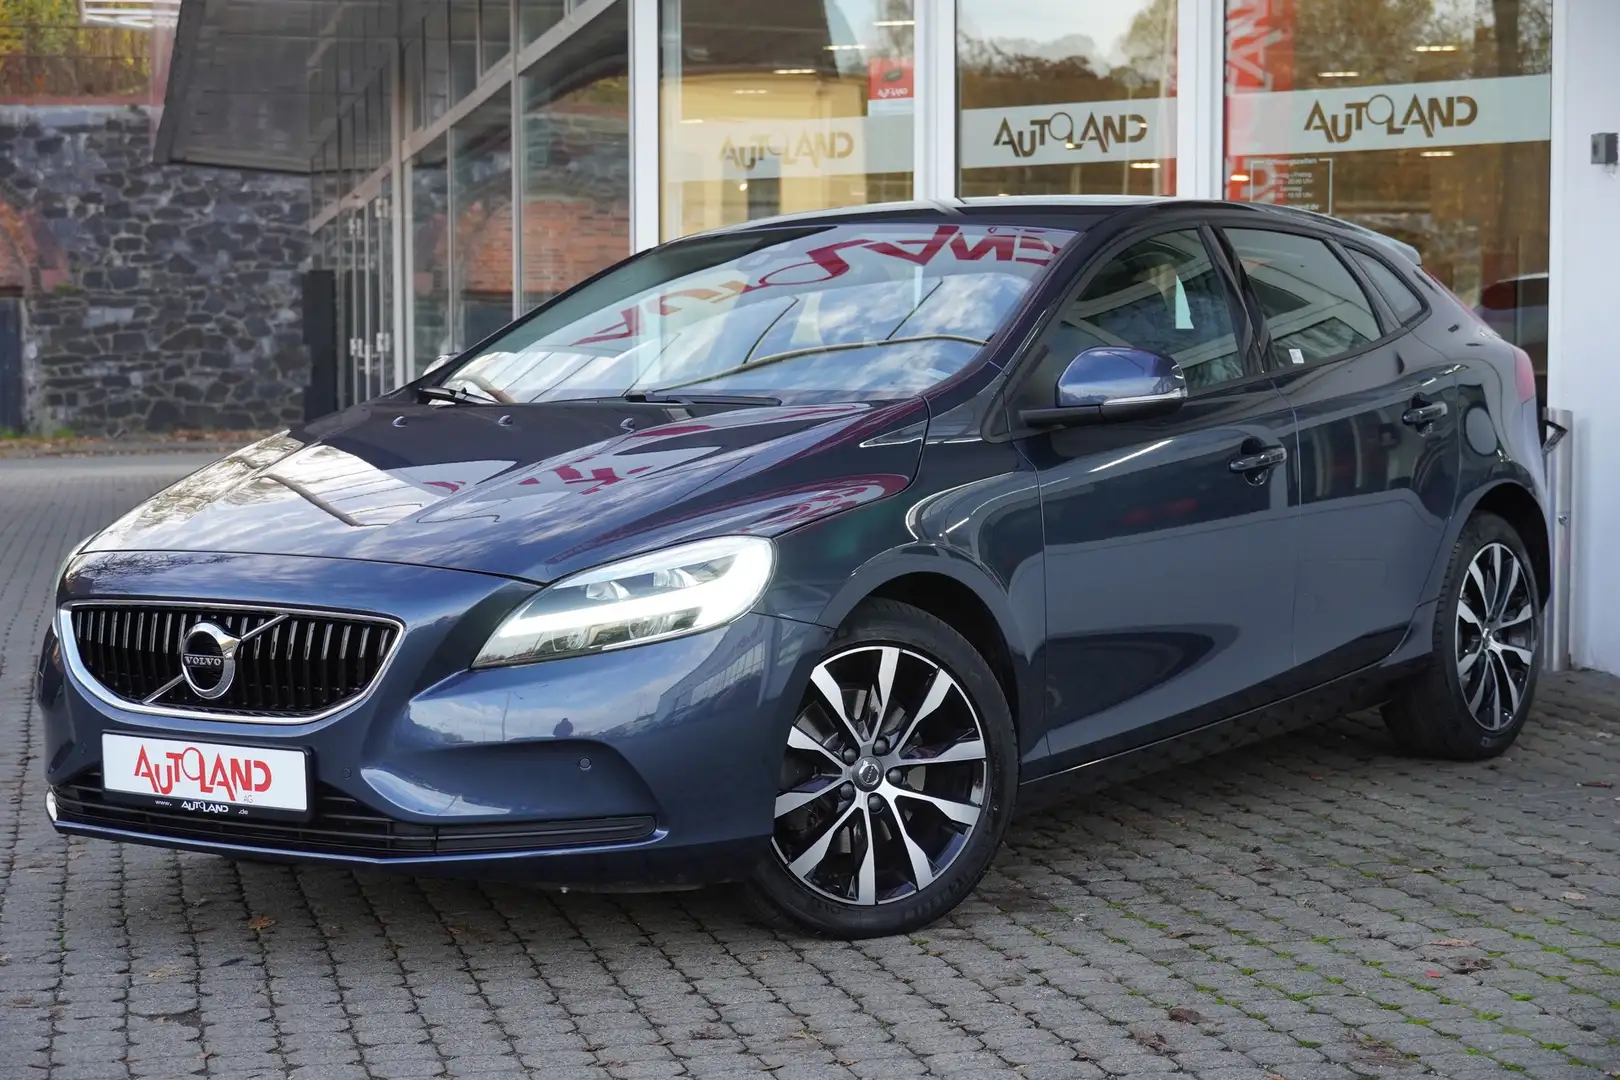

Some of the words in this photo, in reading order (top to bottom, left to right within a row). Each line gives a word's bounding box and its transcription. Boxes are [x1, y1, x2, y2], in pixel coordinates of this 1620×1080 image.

[993, 112, 1147, 157] AUTOLAND
[1304, 93, 1478, 143] AUTOLAND
[718, 129, 854, 170] AUTOLAND
[184, 655, 222, 667] VOLVO
[134, 744, 272, 801] AUTOLAND
[181, 800, 229, 813] AUTOLAND
[243, 794, 254, 803] AG
